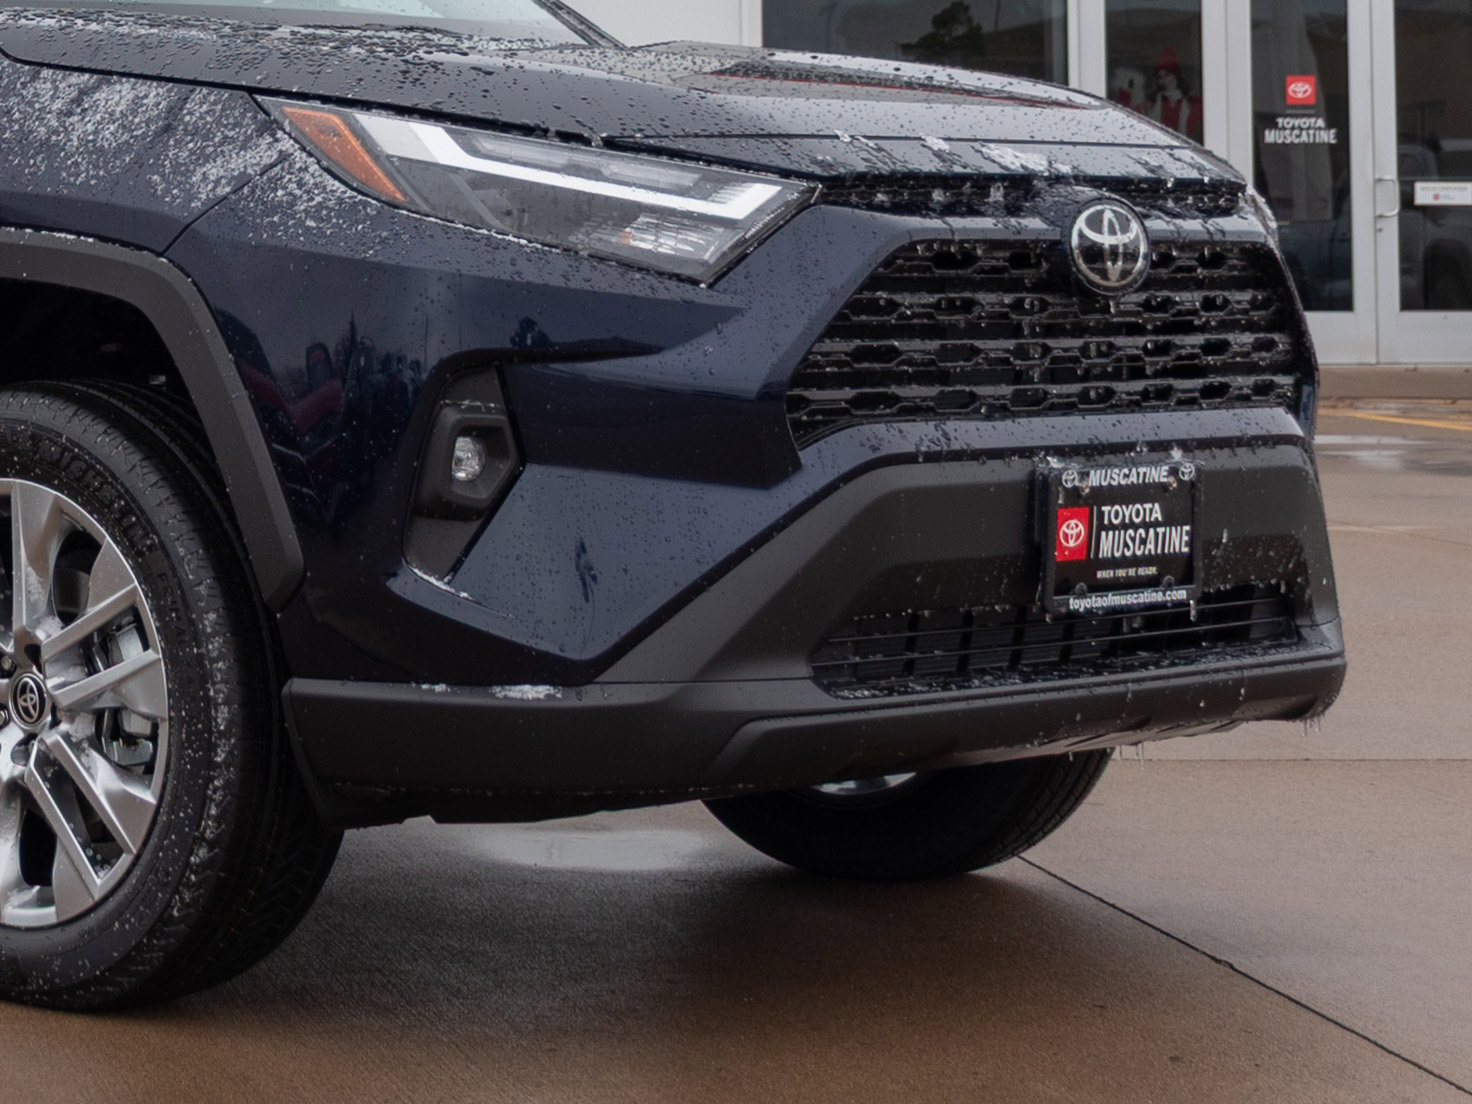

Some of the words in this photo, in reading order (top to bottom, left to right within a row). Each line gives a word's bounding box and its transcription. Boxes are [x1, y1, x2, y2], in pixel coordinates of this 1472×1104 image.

[1276, 116, 1325, 128] TOYOTA
[1264, 128, 1337, 144] MUSCATINE
[1088, 465, 1169, 487] MUSCATINE
[1101, 503, 1163, 525] TOYOTA
[1098, 525, 1191, 559] MUSCATINE
[1068, 589, 1187, 612] toyotaofmuscatine.com
